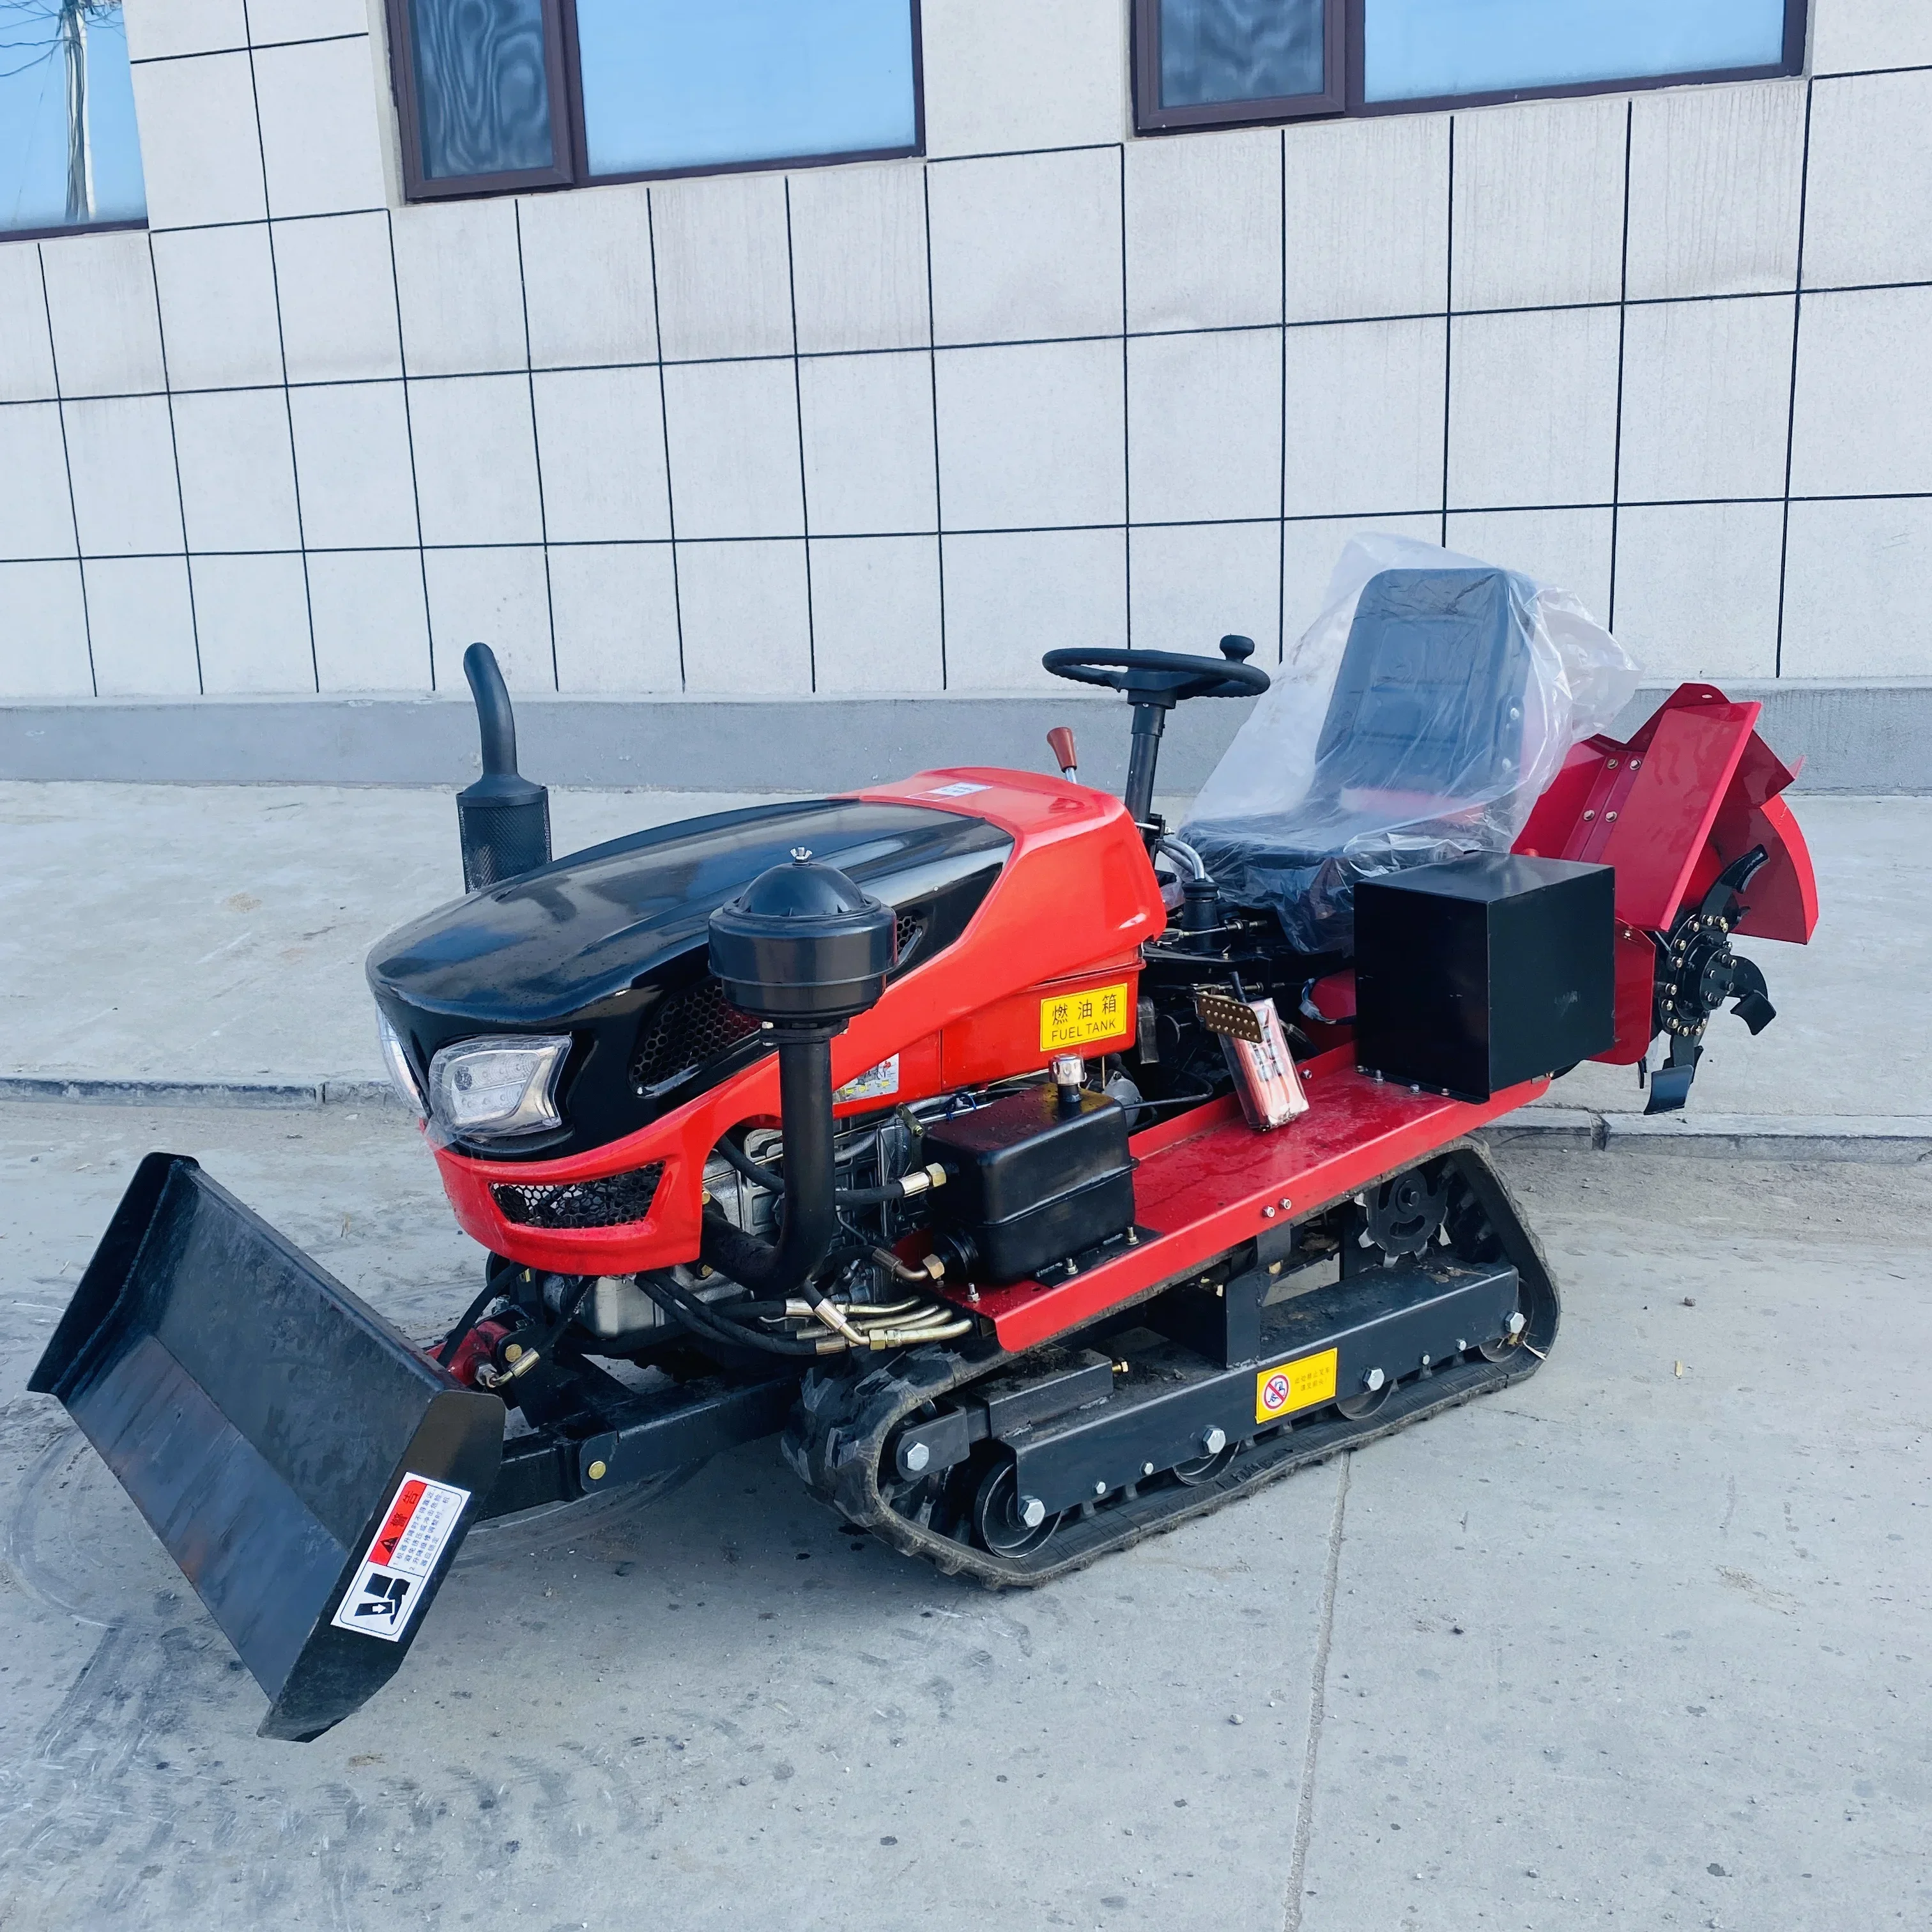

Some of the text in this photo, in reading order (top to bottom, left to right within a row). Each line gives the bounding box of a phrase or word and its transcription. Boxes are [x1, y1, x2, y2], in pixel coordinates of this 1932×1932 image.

[1052, 993, 1117, 1026] 燃油箱
[1052, 1018, 1116, 1042] FUEL TANK
[390, 1491, 418, 1528] 警告
